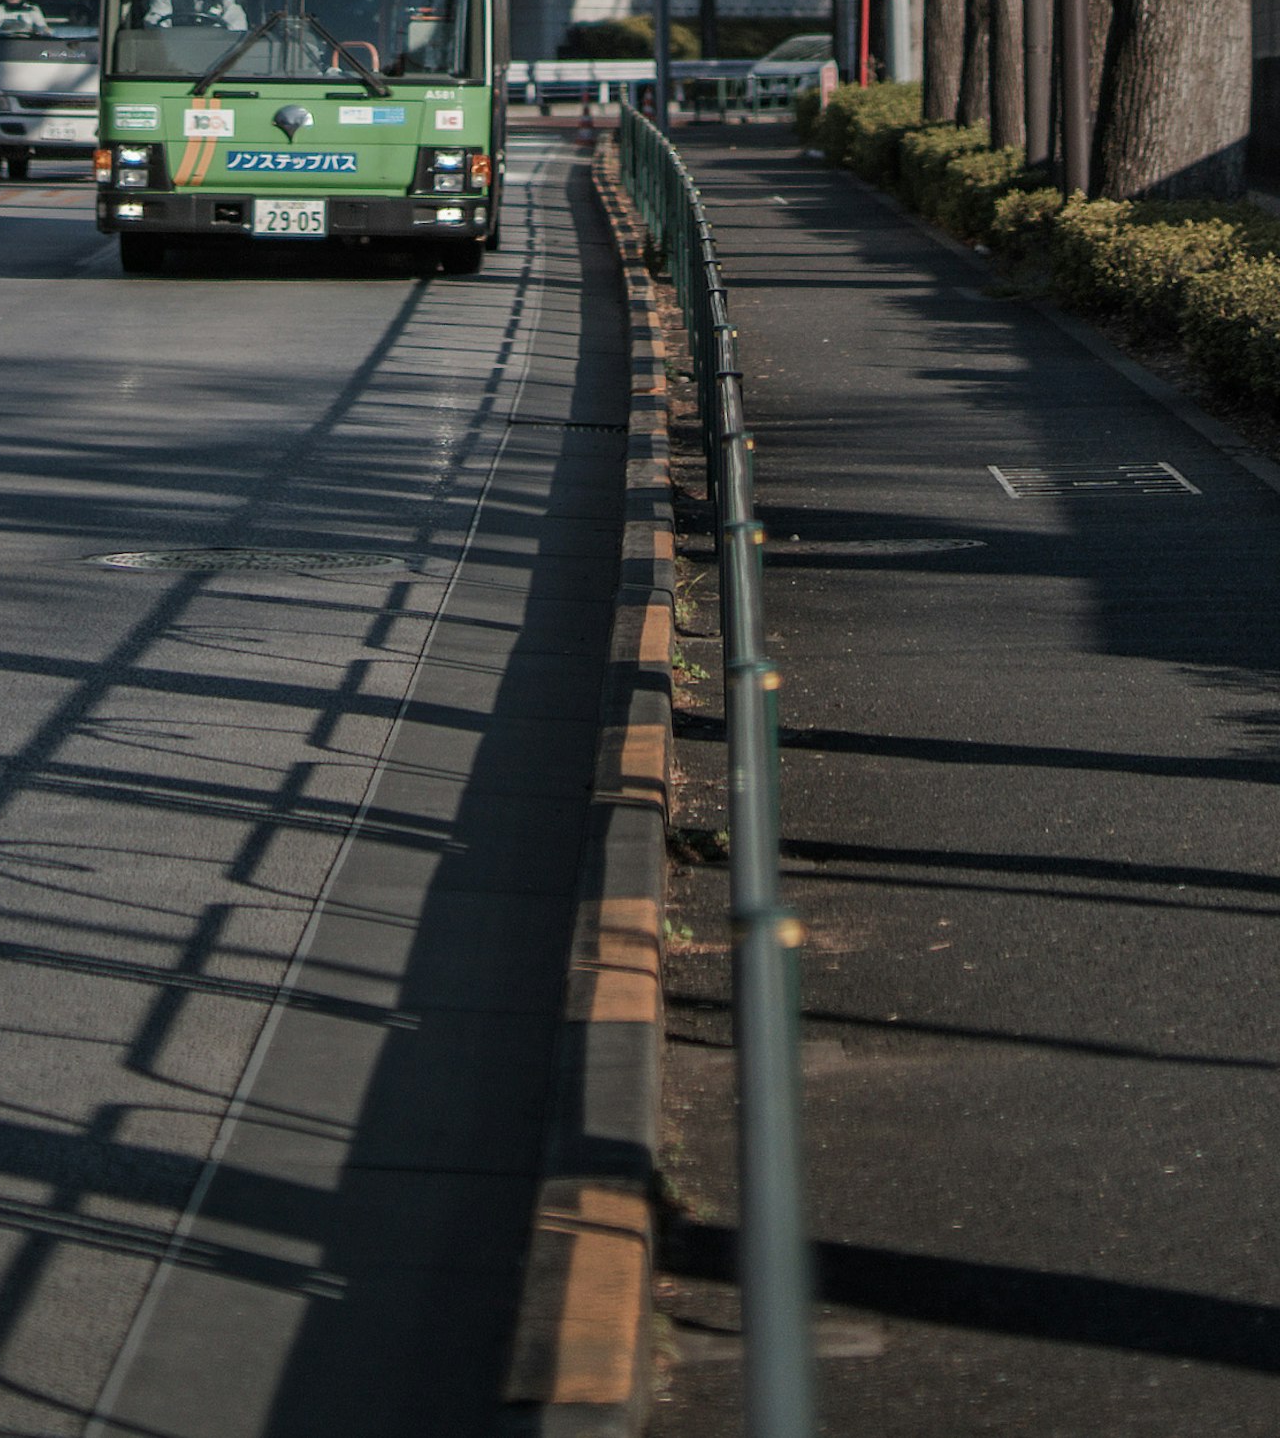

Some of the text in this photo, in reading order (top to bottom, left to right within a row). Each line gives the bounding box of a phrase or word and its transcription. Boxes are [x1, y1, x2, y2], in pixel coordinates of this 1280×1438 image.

[226, 153, 357, 171] ノンステップバス
[266, 211, 323, 232] 29-05
